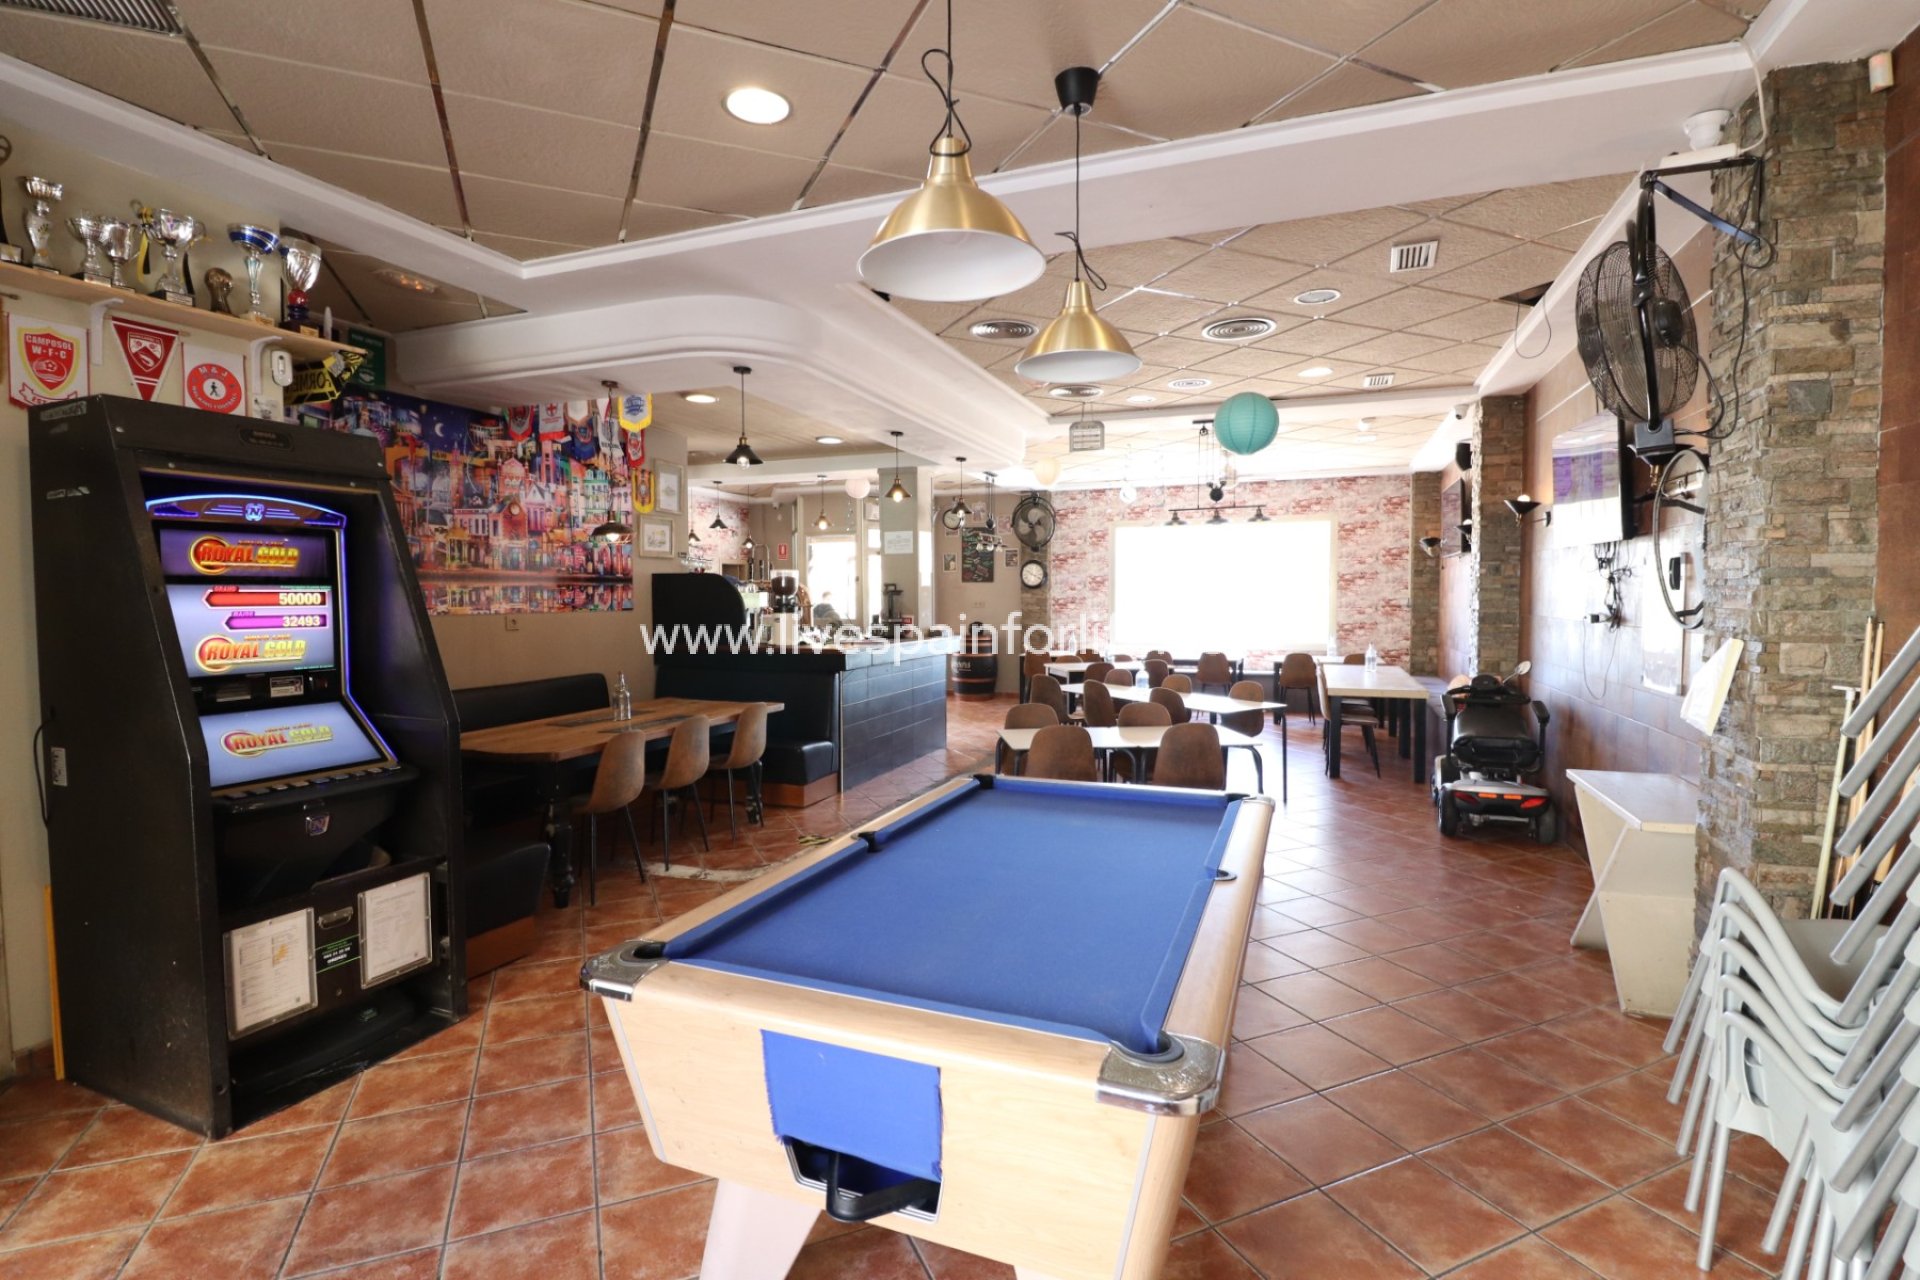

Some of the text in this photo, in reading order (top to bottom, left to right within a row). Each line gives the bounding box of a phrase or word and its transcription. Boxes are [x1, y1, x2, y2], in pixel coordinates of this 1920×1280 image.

[25, 334, 73, 351] CAMPOSOL
[199, 544, 300, 565] ROYAL GOLD
[278, 592, 322, 606] 50000
[282, 615, 321, 628] 32493
[205, 639, 307, 662] ROYAL GOLD
[233, 733, 288, 750] ROYAL
[288, 726, 333, 743] GOLD
